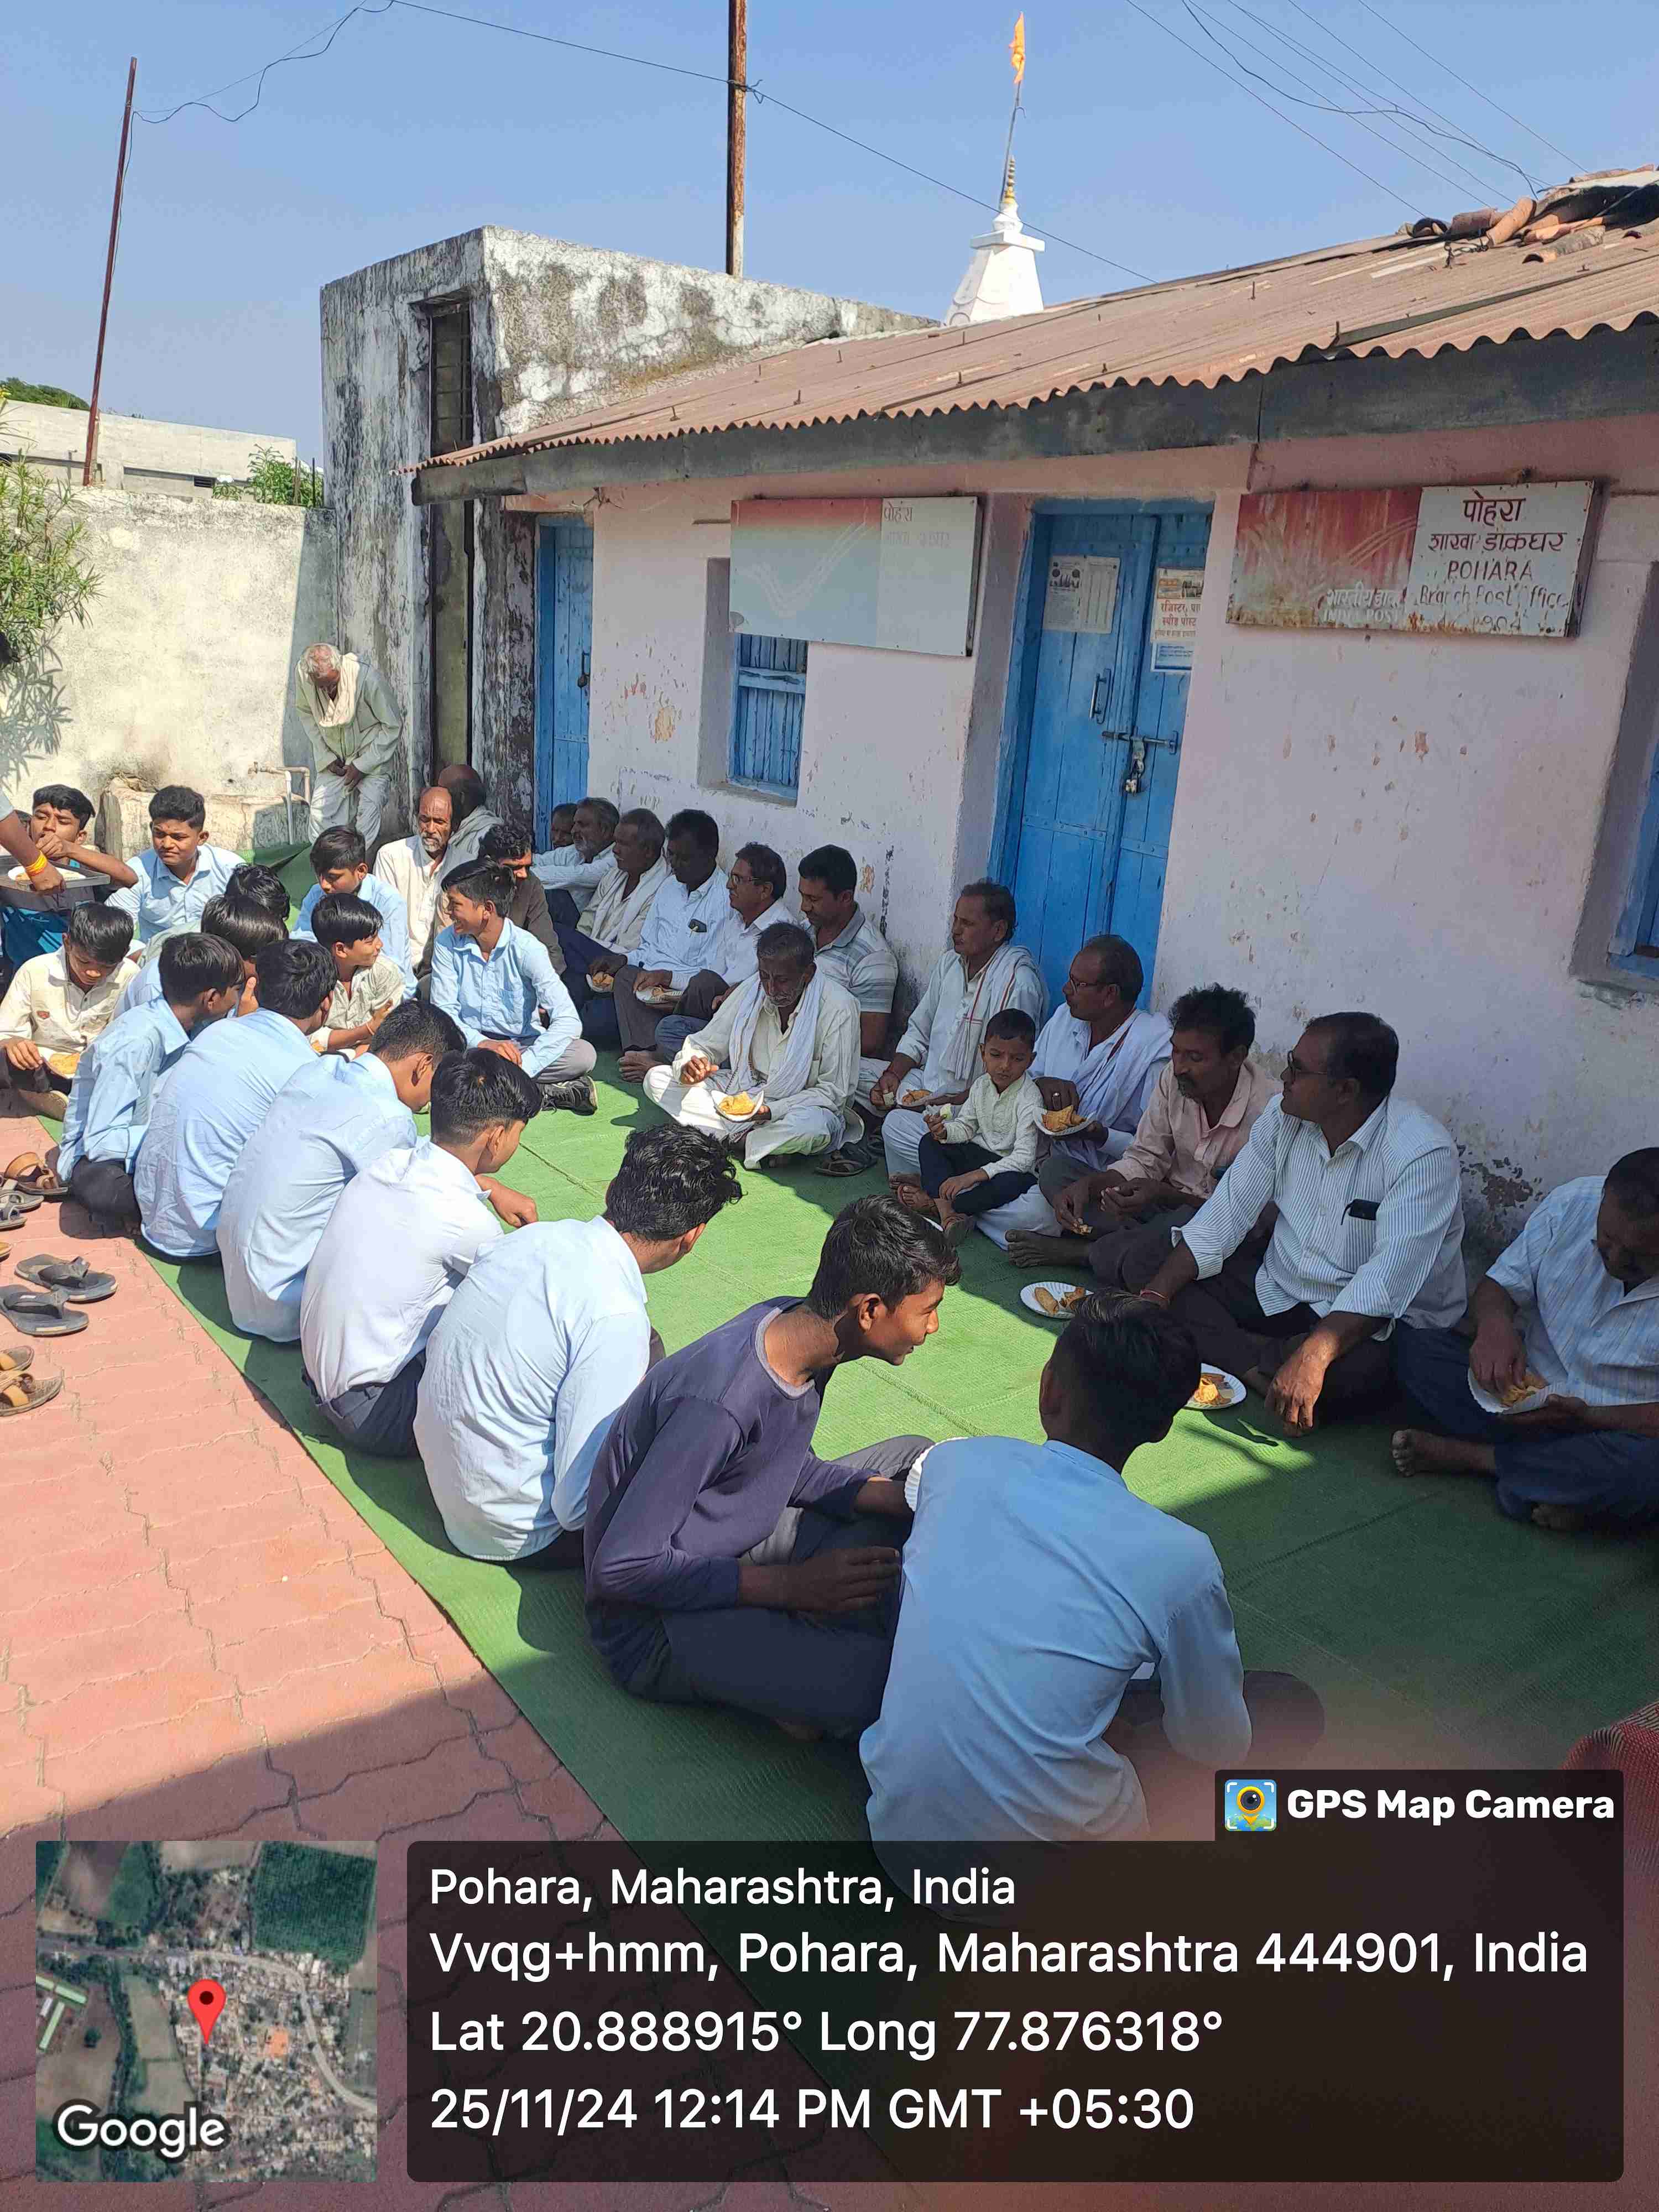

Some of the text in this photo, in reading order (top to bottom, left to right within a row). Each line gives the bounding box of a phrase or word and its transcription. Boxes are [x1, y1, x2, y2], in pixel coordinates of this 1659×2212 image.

[1463, 488, 1526, 526] पोहरा
[1428, 532, 1567, 552] शाखा डाकघर
[1447, 560, 1533, 581] POHARA
